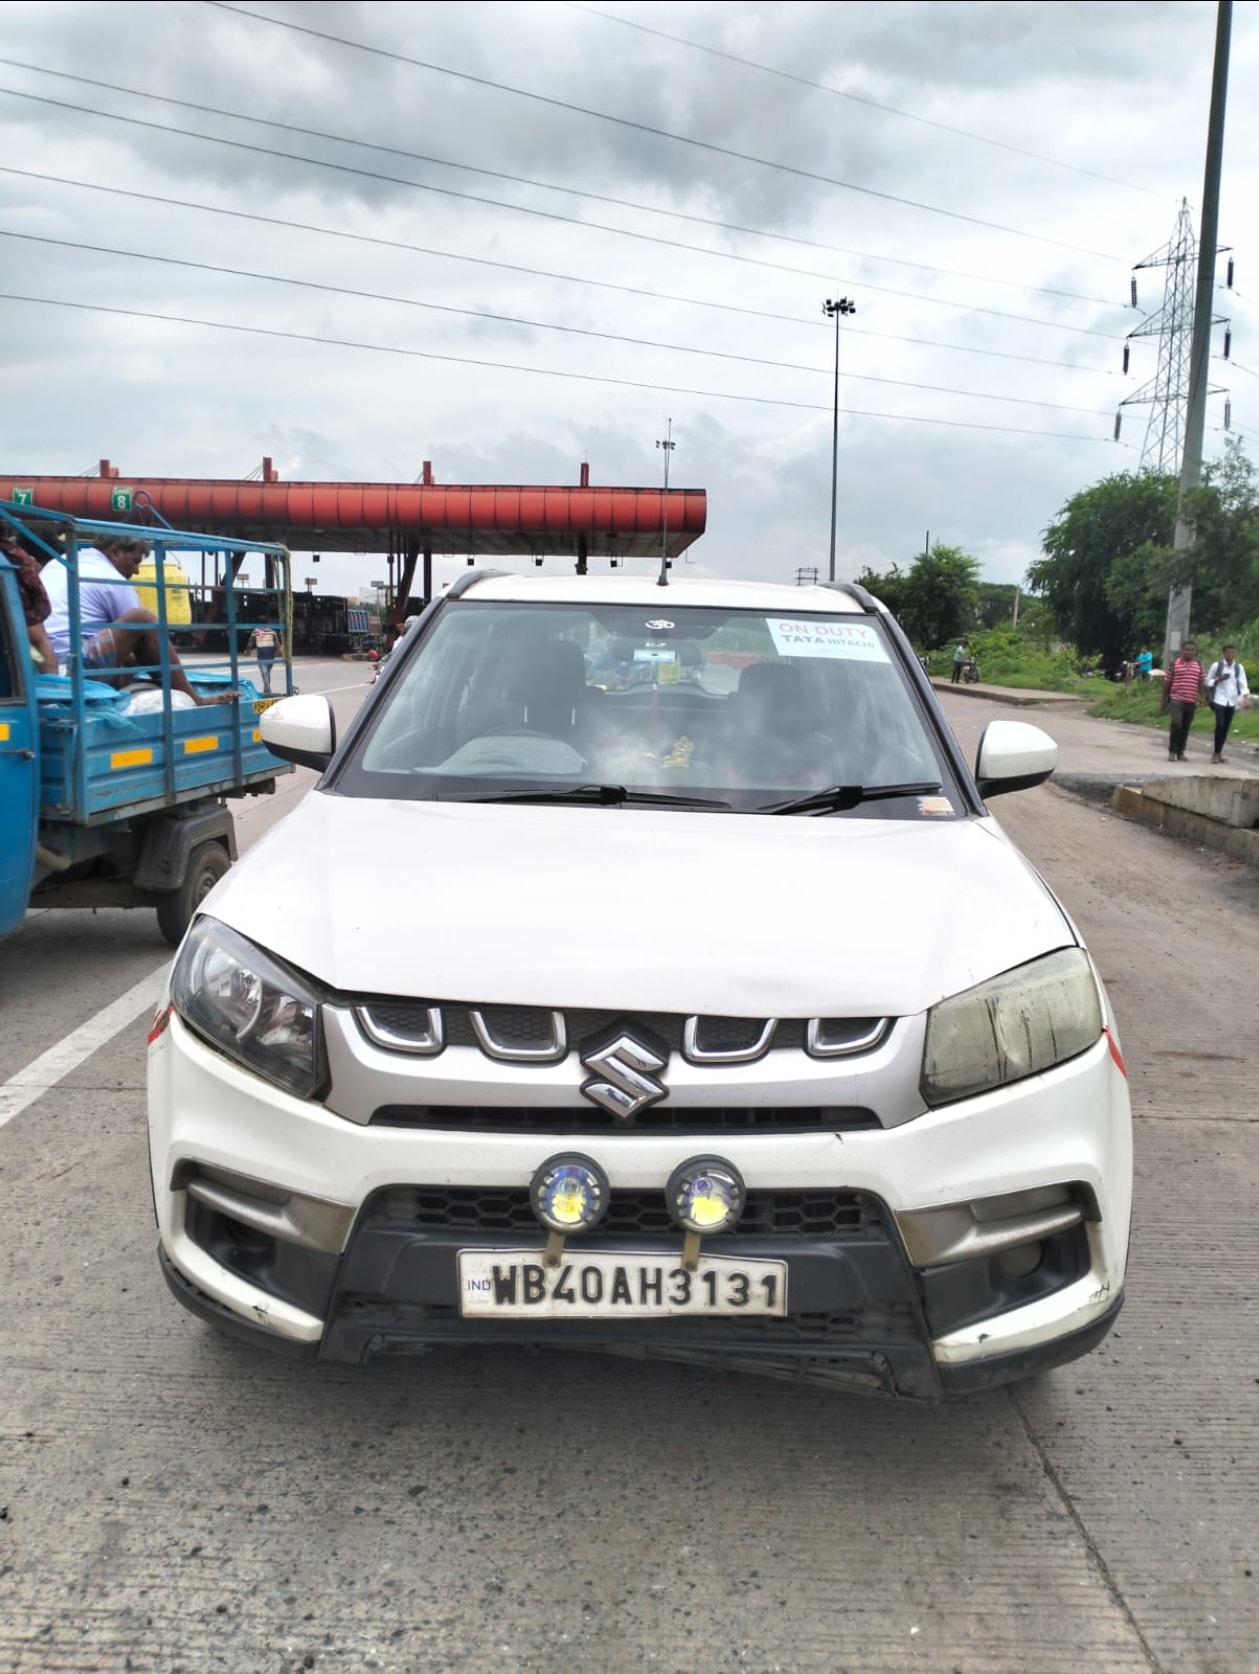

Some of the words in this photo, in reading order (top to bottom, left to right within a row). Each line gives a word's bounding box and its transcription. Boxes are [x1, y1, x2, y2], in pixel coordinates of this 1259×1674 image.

[18, 494, 27, 505] 7
[117, 495, 126, 509] 8
[779, 623, 809, 635] ON
[815, 625, 867, 638] DUTY
[782, 635, 825, 644] TATA
[828, 638, 876, 649] HITACHI
[467, 1279, 491, 1291] IND
[492, 1264, 777, 1308] WB40AH3131
